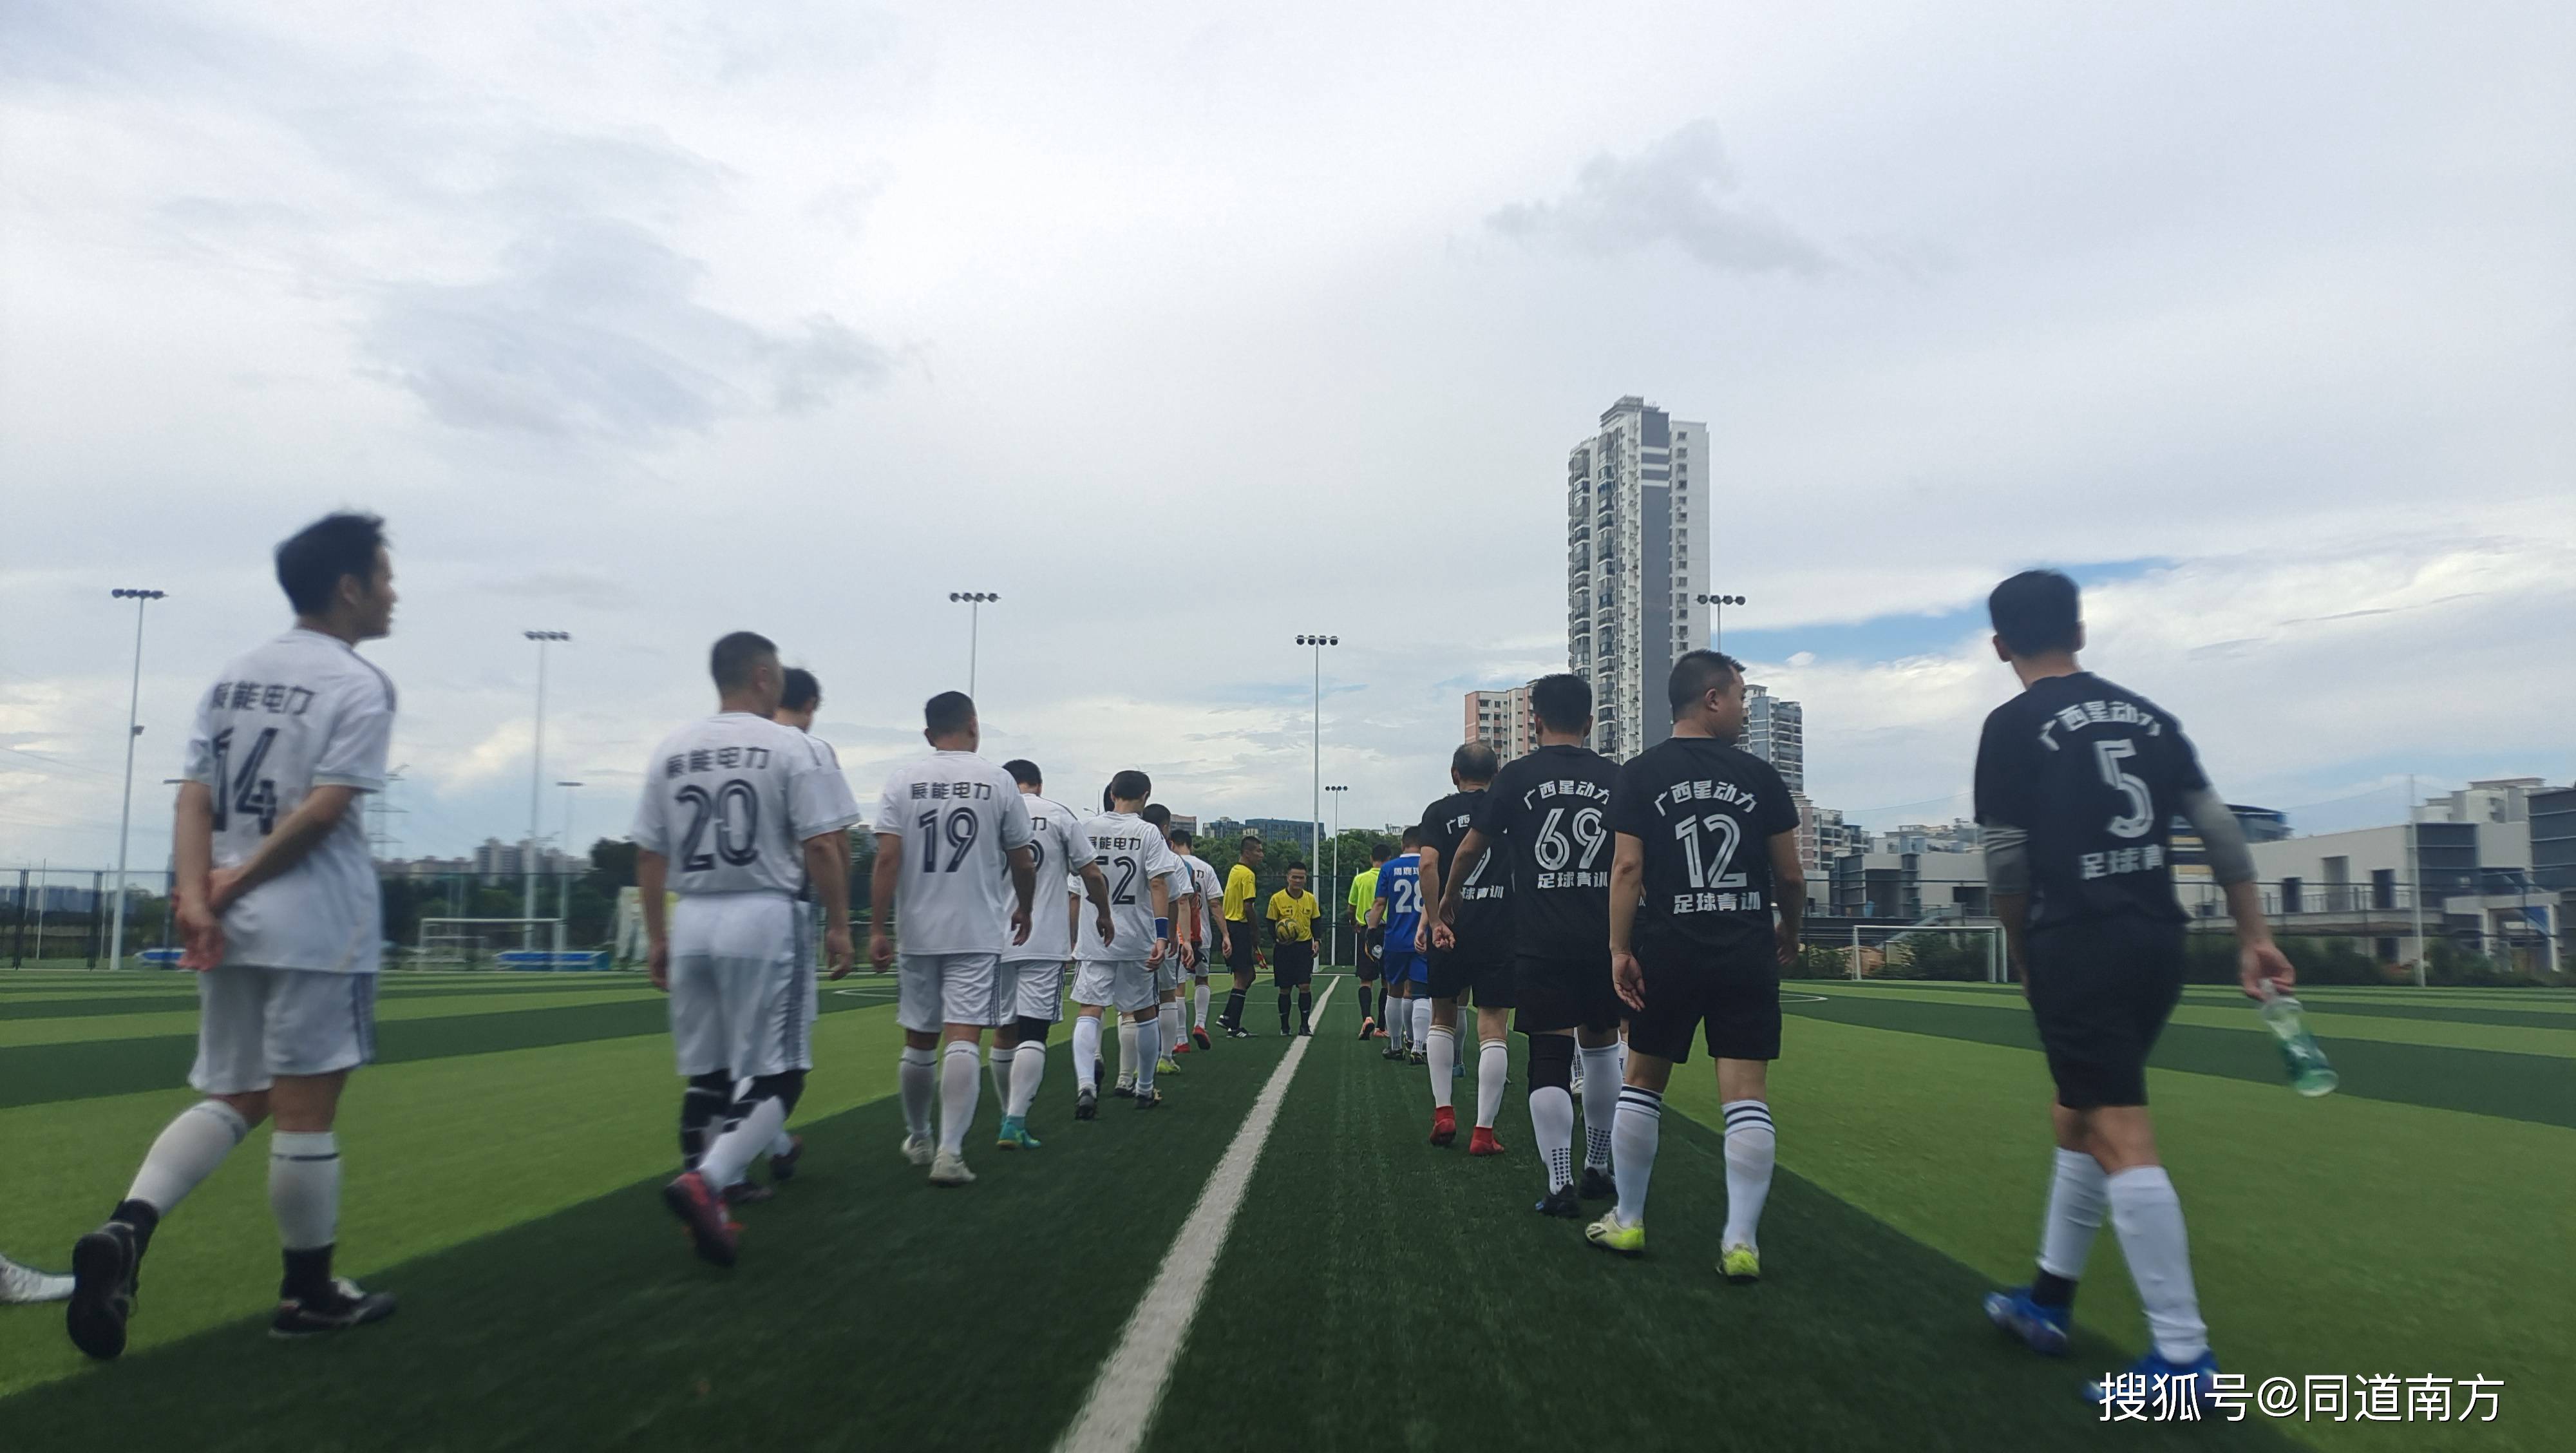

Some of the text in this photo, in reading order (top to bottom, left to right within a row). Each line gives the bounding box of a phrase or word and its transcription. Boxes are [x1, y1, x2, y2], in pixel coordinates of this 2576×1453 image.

[212, 727, 279, 835] 14
[1524, 780, 1611, 810] 广西星动力
[1654, 780, 1758, 817] 广西星动力
[2094, 738, 2155, 838] 5
[674, 779, 759, 873] 20
[919, 806, 979, 873] 19
[1535, 807, 1607, 871] 69
[1675, 813, 1748, 889] 12
[1537, 871, 1608, 889] 足球青训
[1674, 891, 1761, 915] 足球青训
